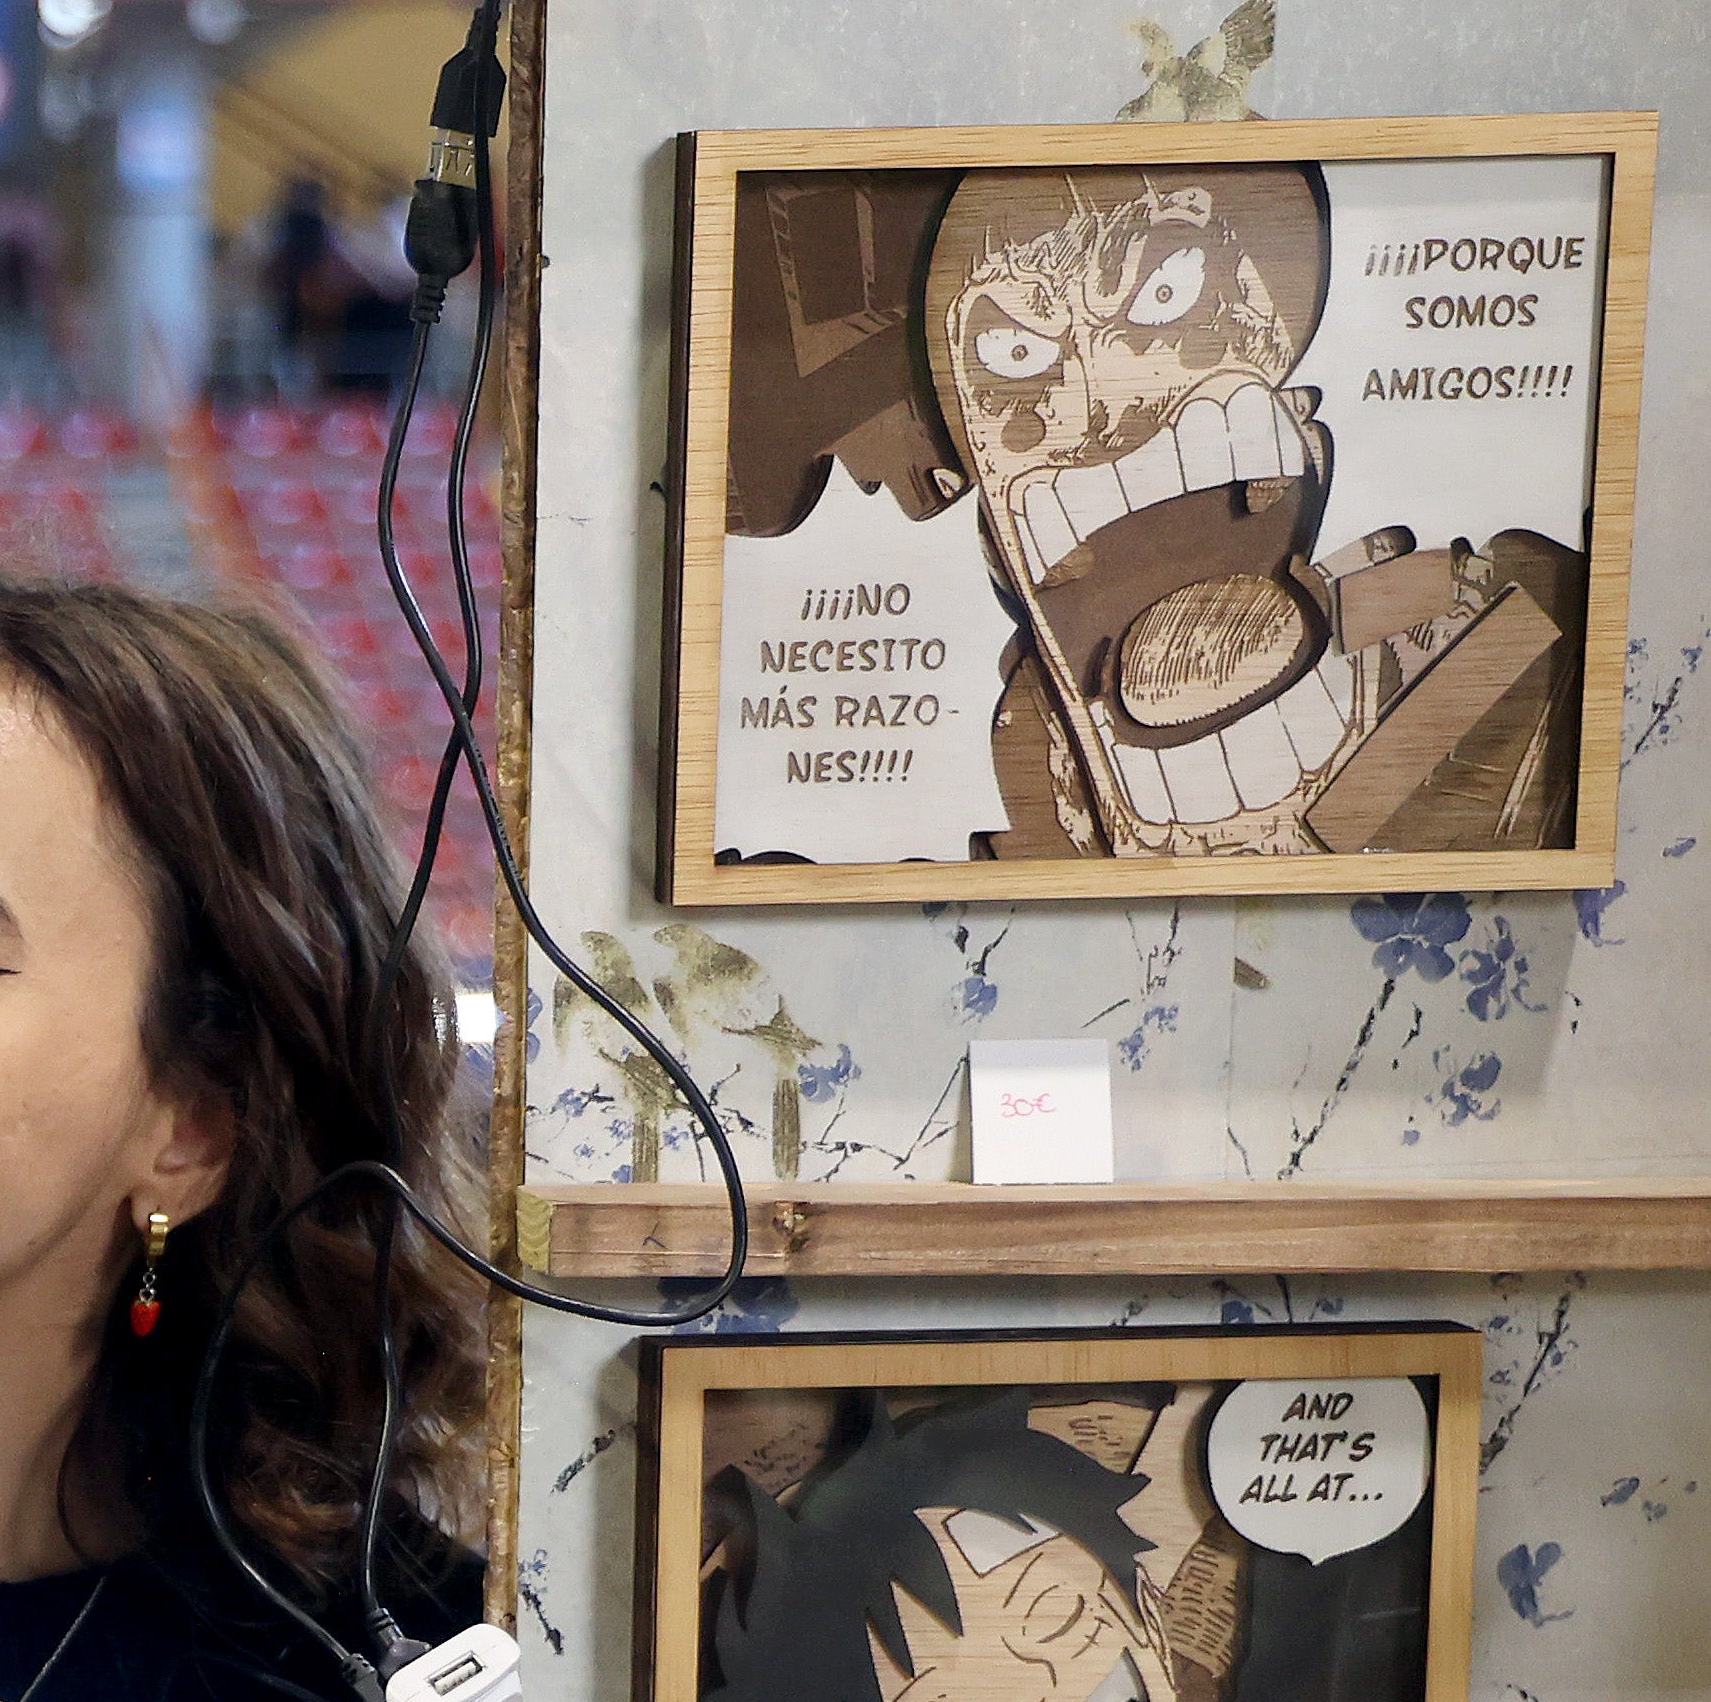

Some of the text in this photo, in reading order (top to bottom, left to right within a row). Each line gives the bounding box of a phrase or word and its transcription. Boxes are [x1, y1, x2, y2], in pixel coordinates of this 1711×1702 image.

[1363, 234, 1586, 280] ¡¡¡¡PORQUE
[1404, 293, 1539, 330] SOMOS
[1361, 364, 1574, 402] AMIGOS!!!!
[800, 581, 911, 622] ¡¡¡¡NO
[760, 636, 948, 675] NECESITO
[740, 692, 961, 731] MÁS RAZO-
[785, 747, 913, 787] NES!!!!
[1001, 1093, 1058, 1118] 30€
[1281, 1389, 1355, 1421] AND
[1257, 1428, 1376, 1465] THAT'S
[1238, 1470, 1386, 1506] ALL AT...
